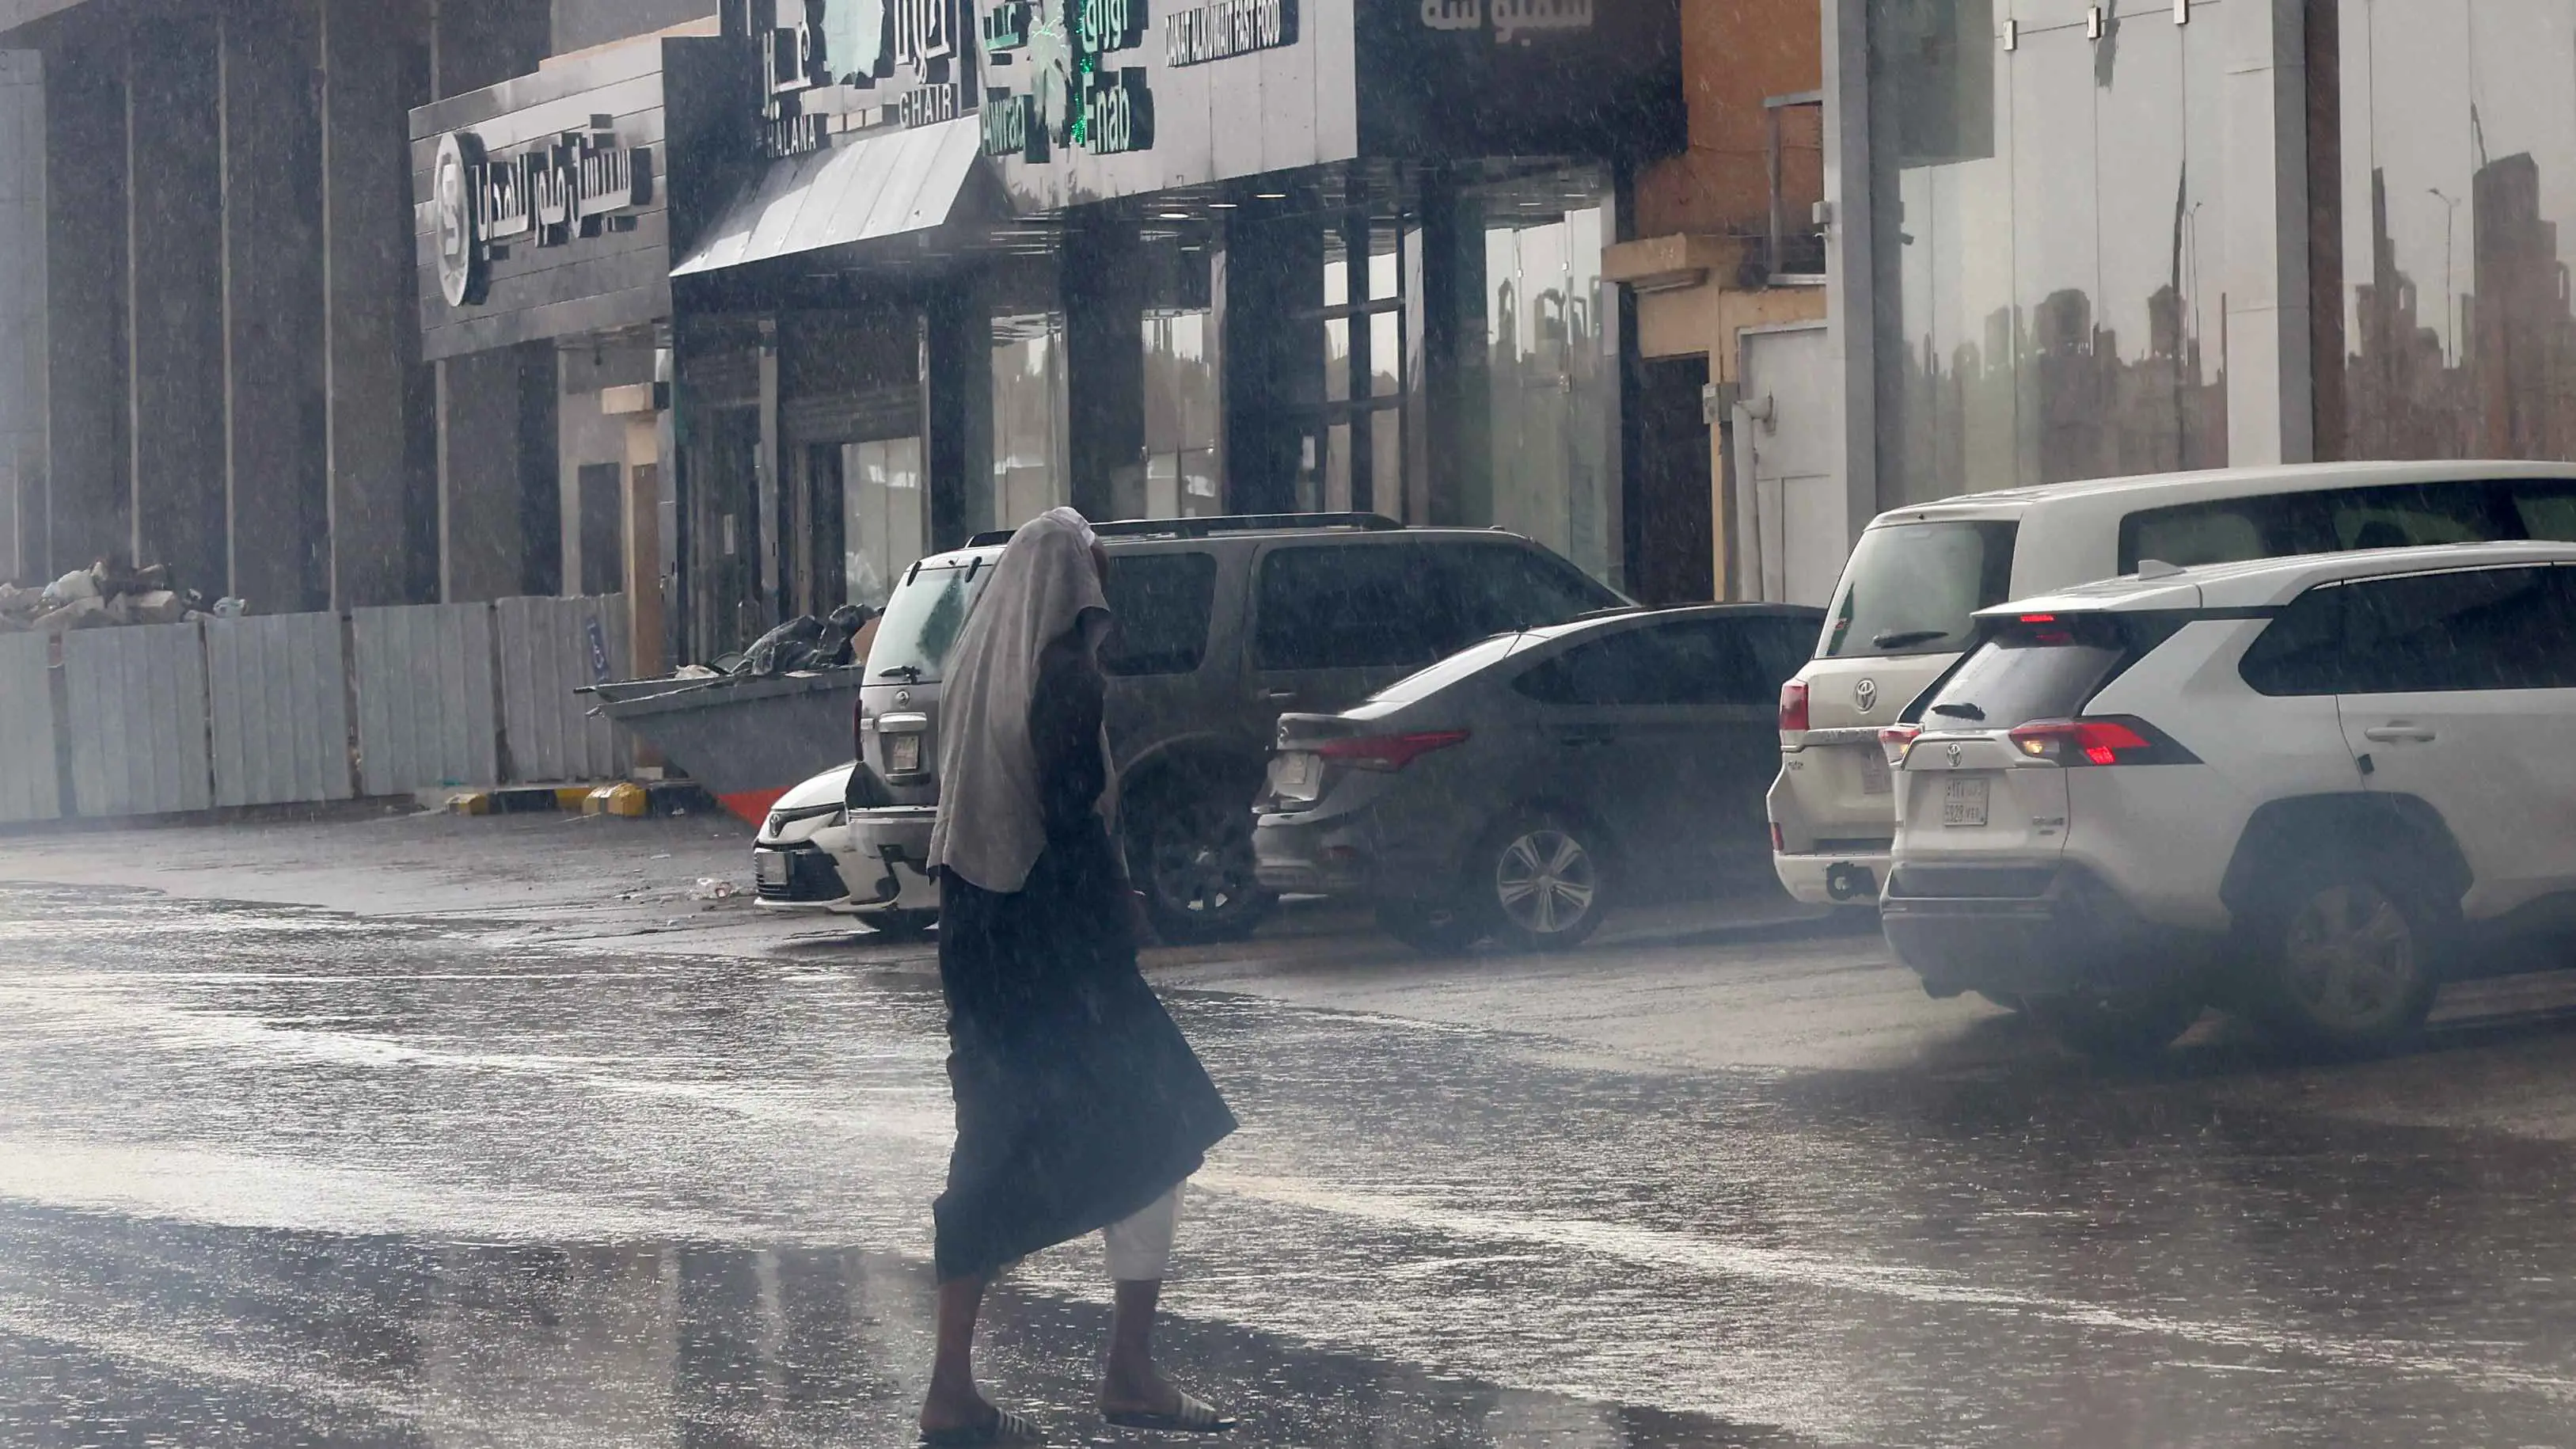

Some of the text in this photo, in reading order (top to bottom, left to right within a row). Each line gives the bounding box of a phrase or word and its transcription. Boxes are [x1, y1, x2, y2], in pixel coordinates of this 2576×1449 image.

[1234, 0, 1255, 51] FAST
[1256, 0, 1281, 48] FOOD
[766, 84, 952, 158] HALANA GHAIR
[1082, 68, 1130, 154] Enab
